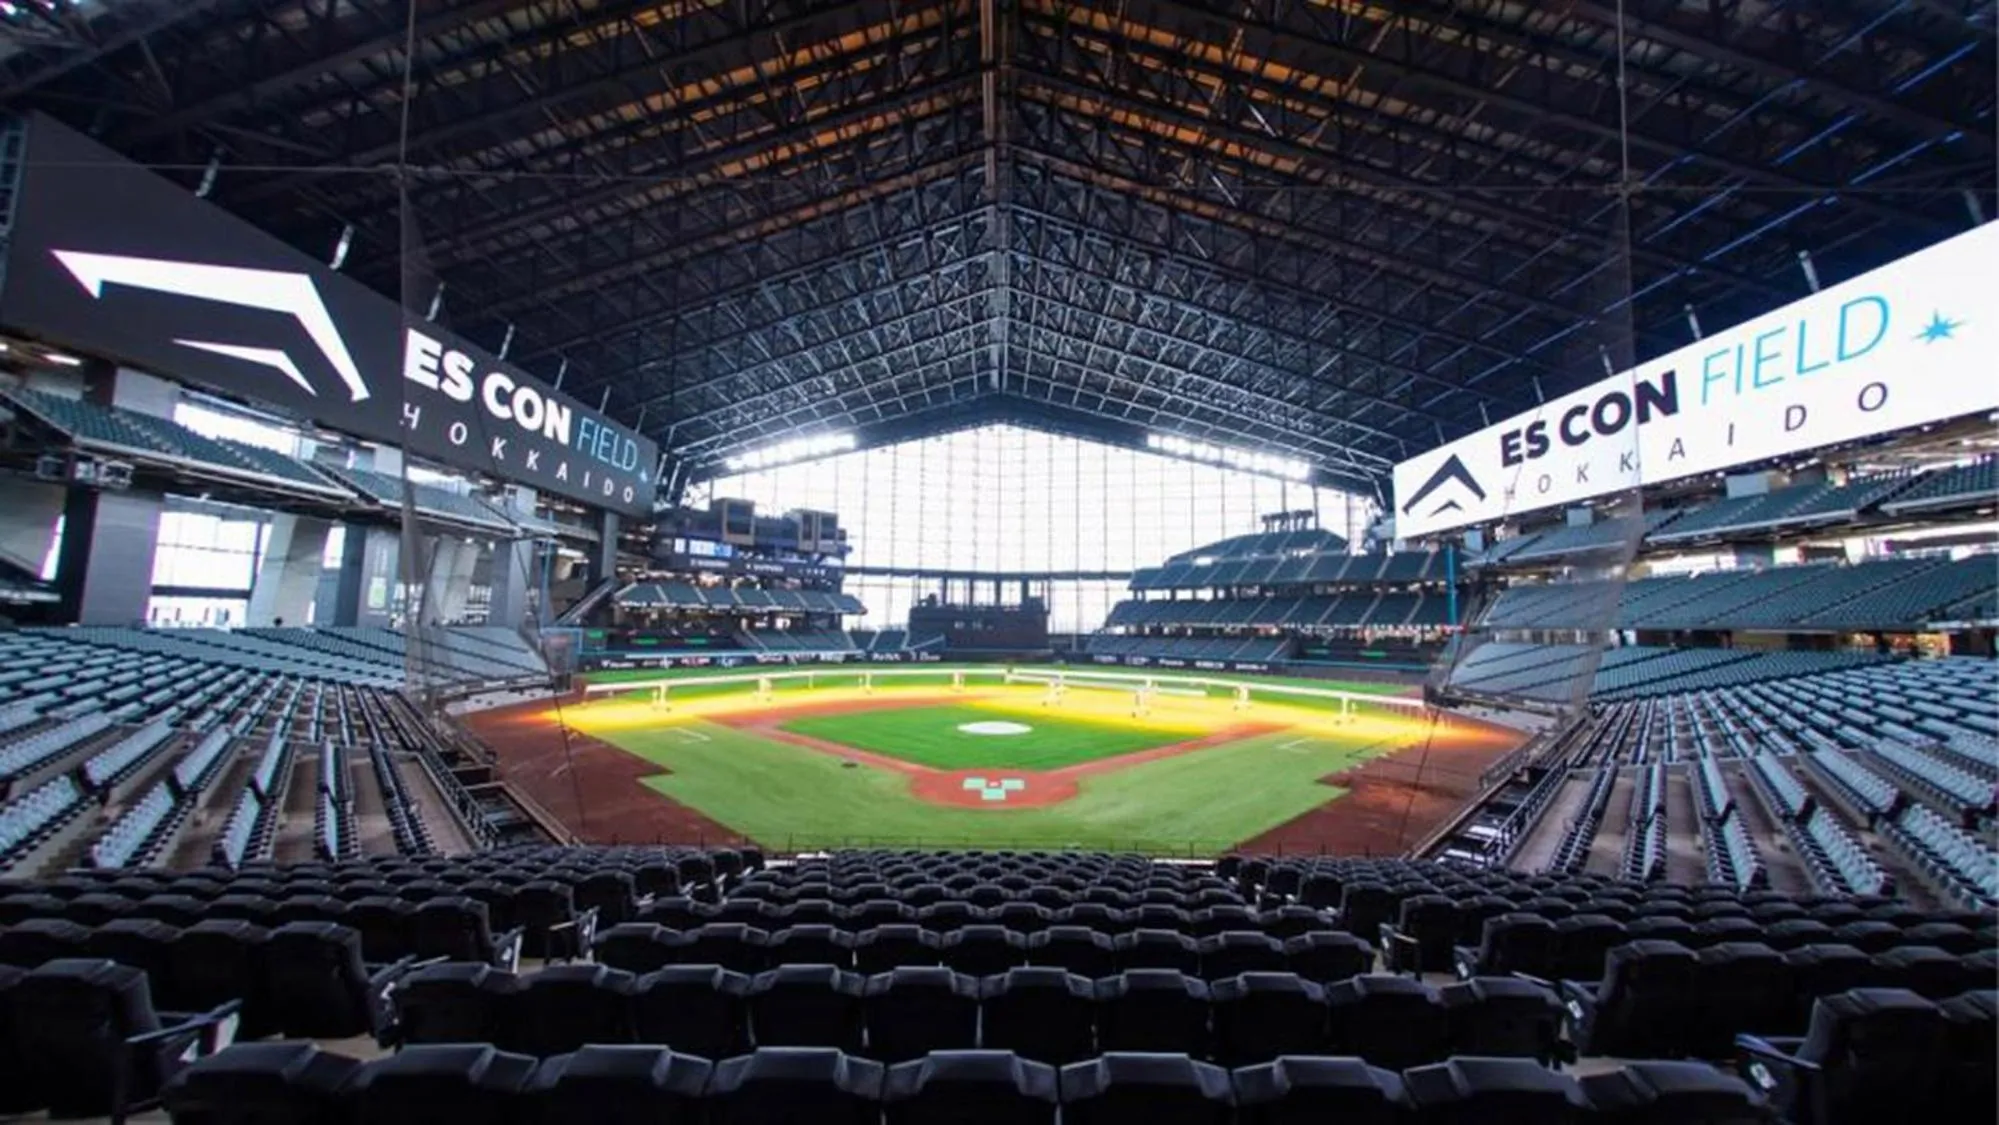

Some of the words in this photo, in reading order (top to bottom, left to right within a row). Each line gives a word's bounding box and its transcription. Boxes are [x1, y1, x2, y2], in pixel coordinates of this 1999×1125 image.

[400, 402, 634, 503] HOKKAIDO
[403, 328, 474, 401] ES
[482, 372, 572, 445] CON
[577, 416, 637, 471] FIELD
[1501, 420, 1550, 468] ES
[1560, 369, 1679, 446] CON
[1701, 296, 1889, 405] FIELD
